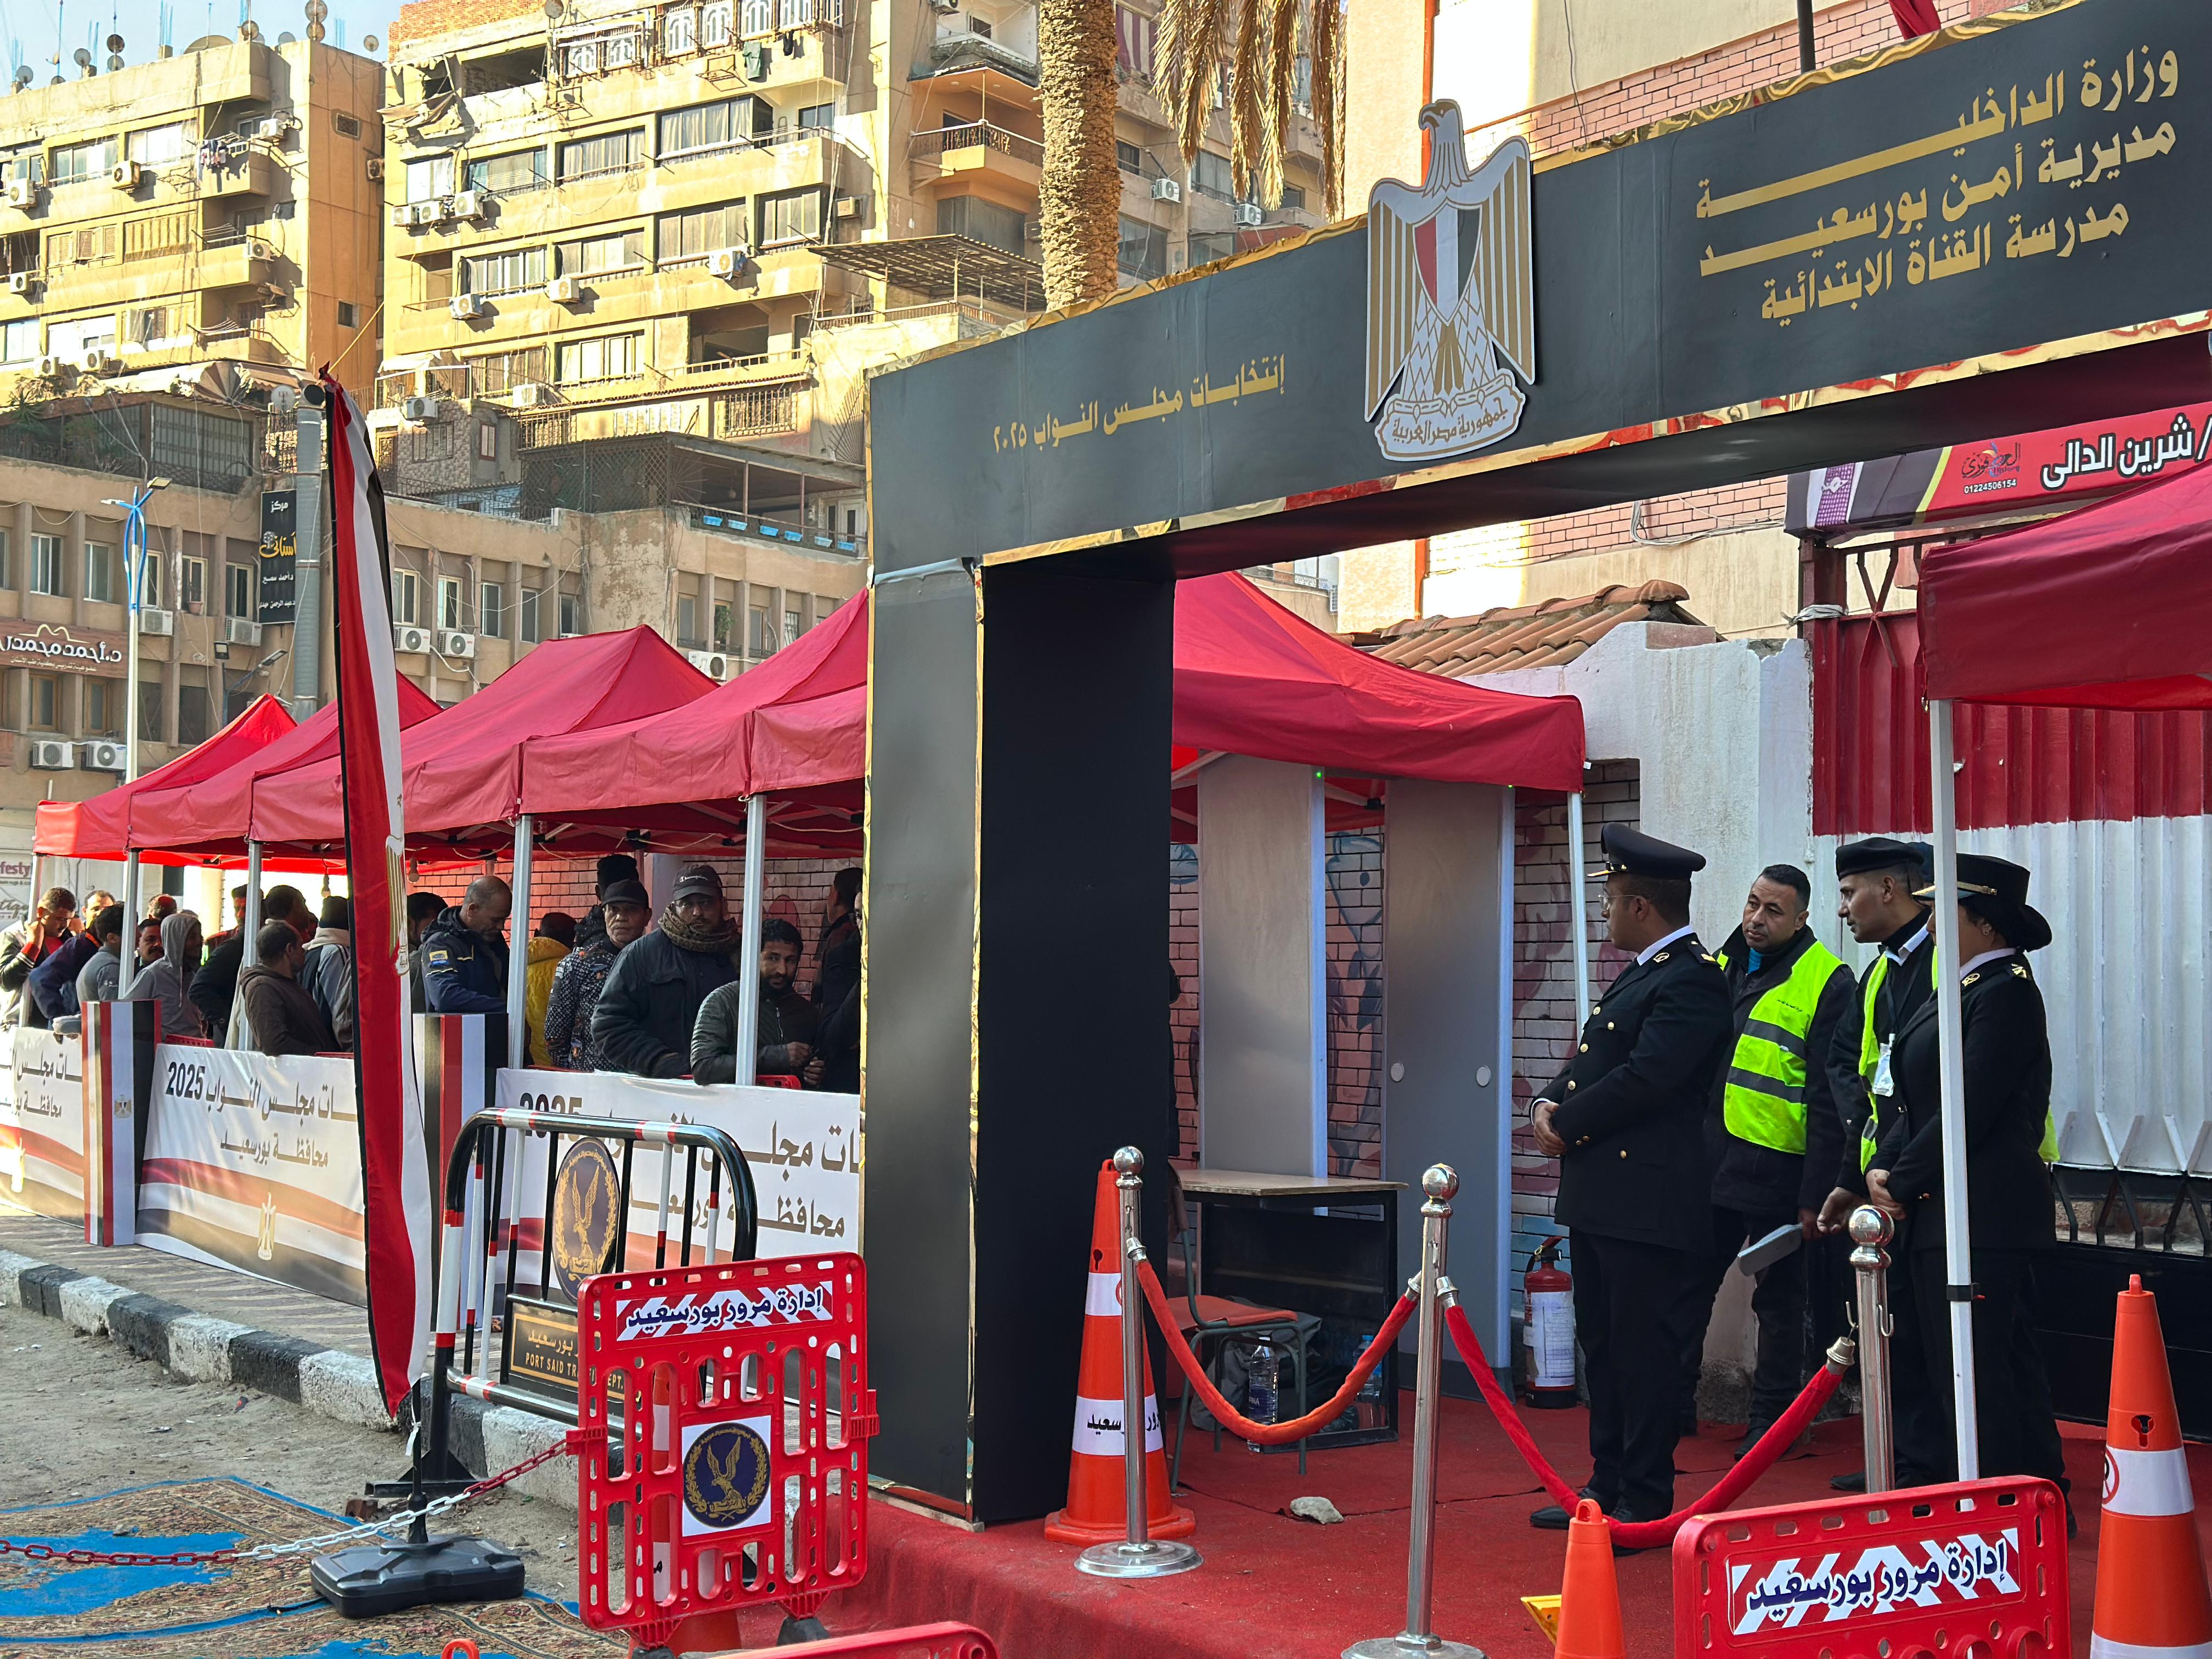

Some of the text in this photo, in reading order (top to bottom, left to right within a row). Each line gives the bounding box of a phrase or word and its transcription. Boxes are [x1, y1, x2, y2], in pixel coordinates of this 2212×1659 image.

[1696, 44, 2179, 218] وزارة الداخلية
[1700, 121, 2176, 276] مديرية أمن بورسعيد
[1761, 202, 2129, 328] مدرسة القناة الابتدائية
[994, 353, 1284, 453] إنتخابات مجلس النواب ٢٠٢٥
[1392, 397, 1508, 445] جمهورية مصر العربية
[270, 500, 289, 514] مركز
[1963, 478, 2017, 494] 01224506154
[165, 1061, 206, 1101] 2025
[205, 1075, 262, 1113] النواب
[261, 1081, 315, 1128] مجلس
[220, 1128, 329, 1167] محافظة بورسعيد
[628, 1288, 822, 1331] إدارة مرور بورسعيد
[528, 1329, 573, 1357] بورسعيد
[526, 1352, 544, 1371] PORT
[546, 1358, 564, 1374] SAID
[607, 1373, 624, 1390] EPT.
[1750, 1543, 2005, 1617] إدارة مرور بورسعيد
